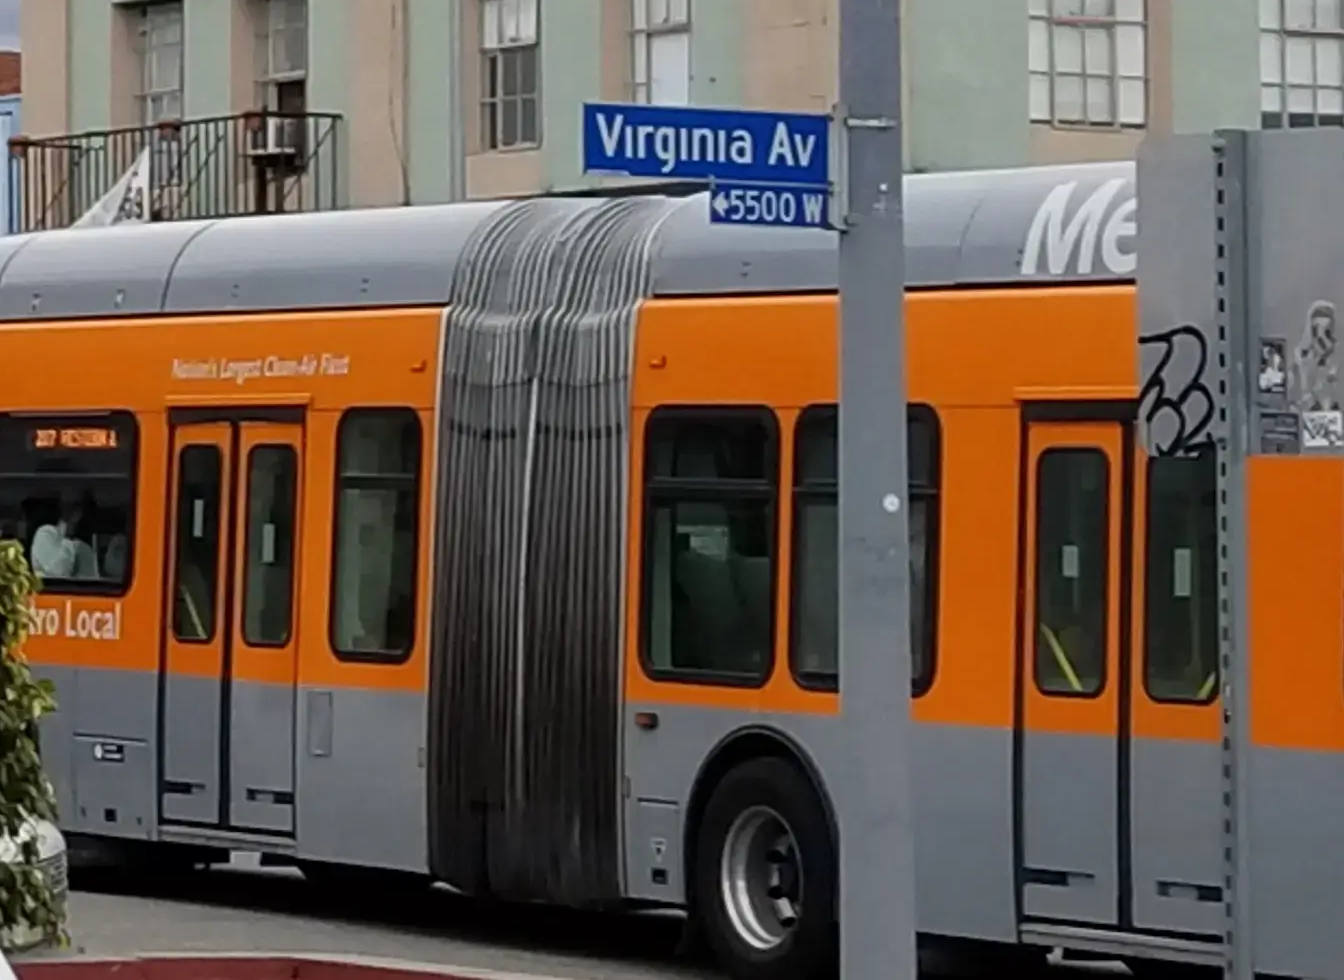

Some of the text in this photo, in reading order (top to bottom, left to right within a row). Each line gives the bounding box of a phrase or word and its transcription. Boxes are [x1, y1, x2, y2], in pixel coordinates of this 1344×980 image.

[596, 113, 816, 173] Virginia Av
[730, 191, 823, 224] 5500 W
[65, 600, 122, 640] Local
